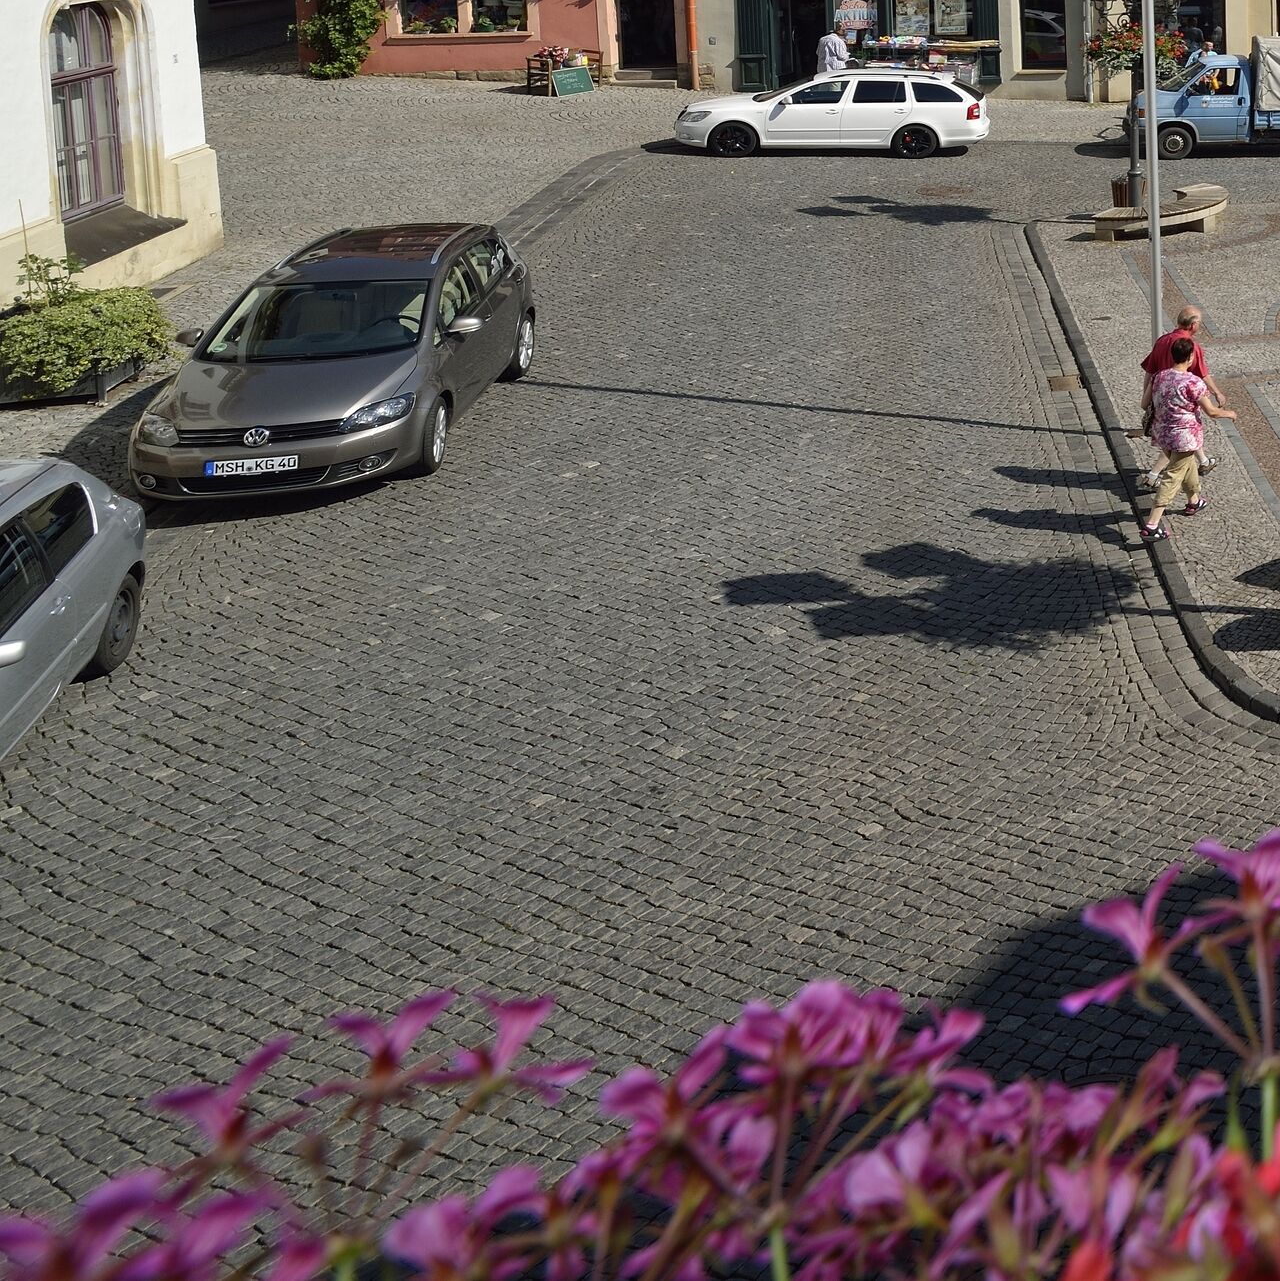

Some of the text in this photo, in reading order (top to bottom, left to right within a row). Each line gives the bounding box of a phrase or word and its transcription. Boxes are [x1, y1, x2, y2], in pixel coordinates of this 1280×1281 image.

[214, 457, 297, 474] MSH KG 40
